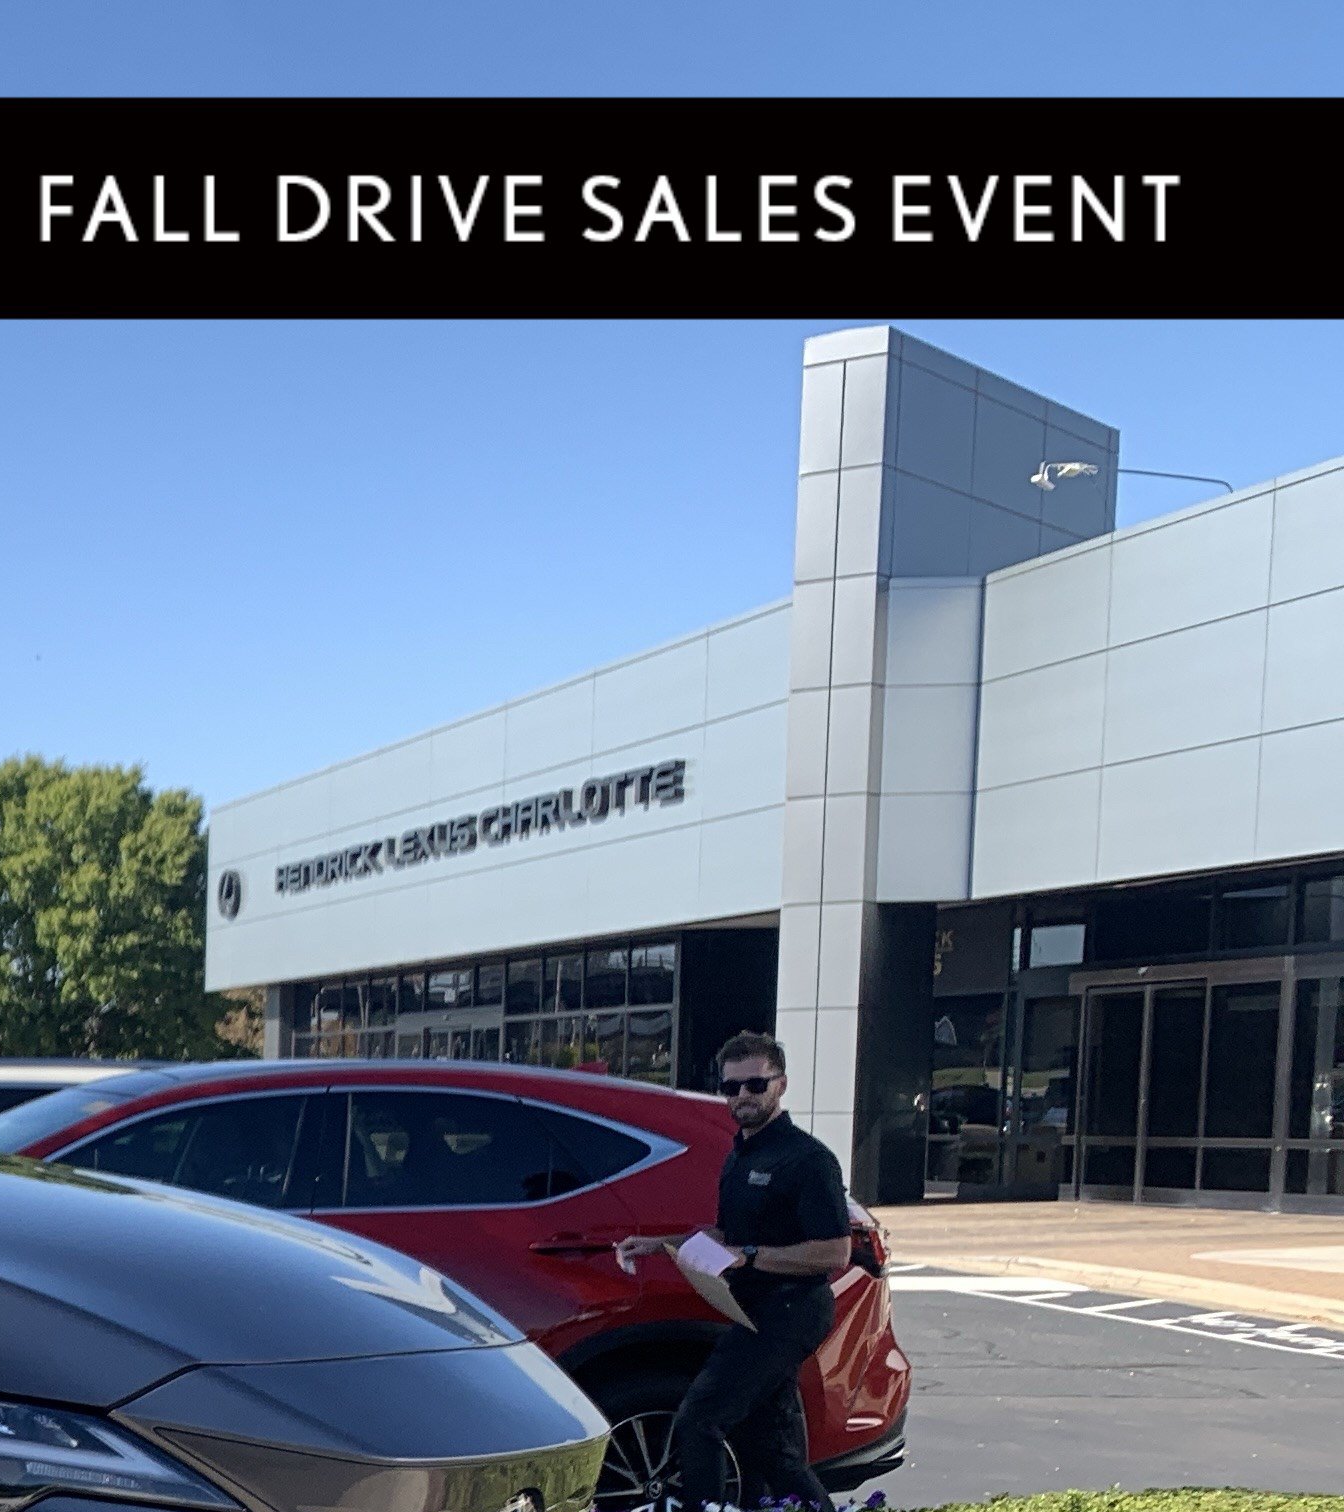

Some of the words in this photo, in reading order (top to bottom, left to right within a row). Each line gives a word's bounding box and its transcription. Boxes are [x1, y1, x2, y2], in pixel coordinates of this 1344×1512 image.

[275, 839, 382, 894] HENDRICK
[382, 814, 477, 870] LEXUS
[477, 759, 687, 847] CHARLOTTE
